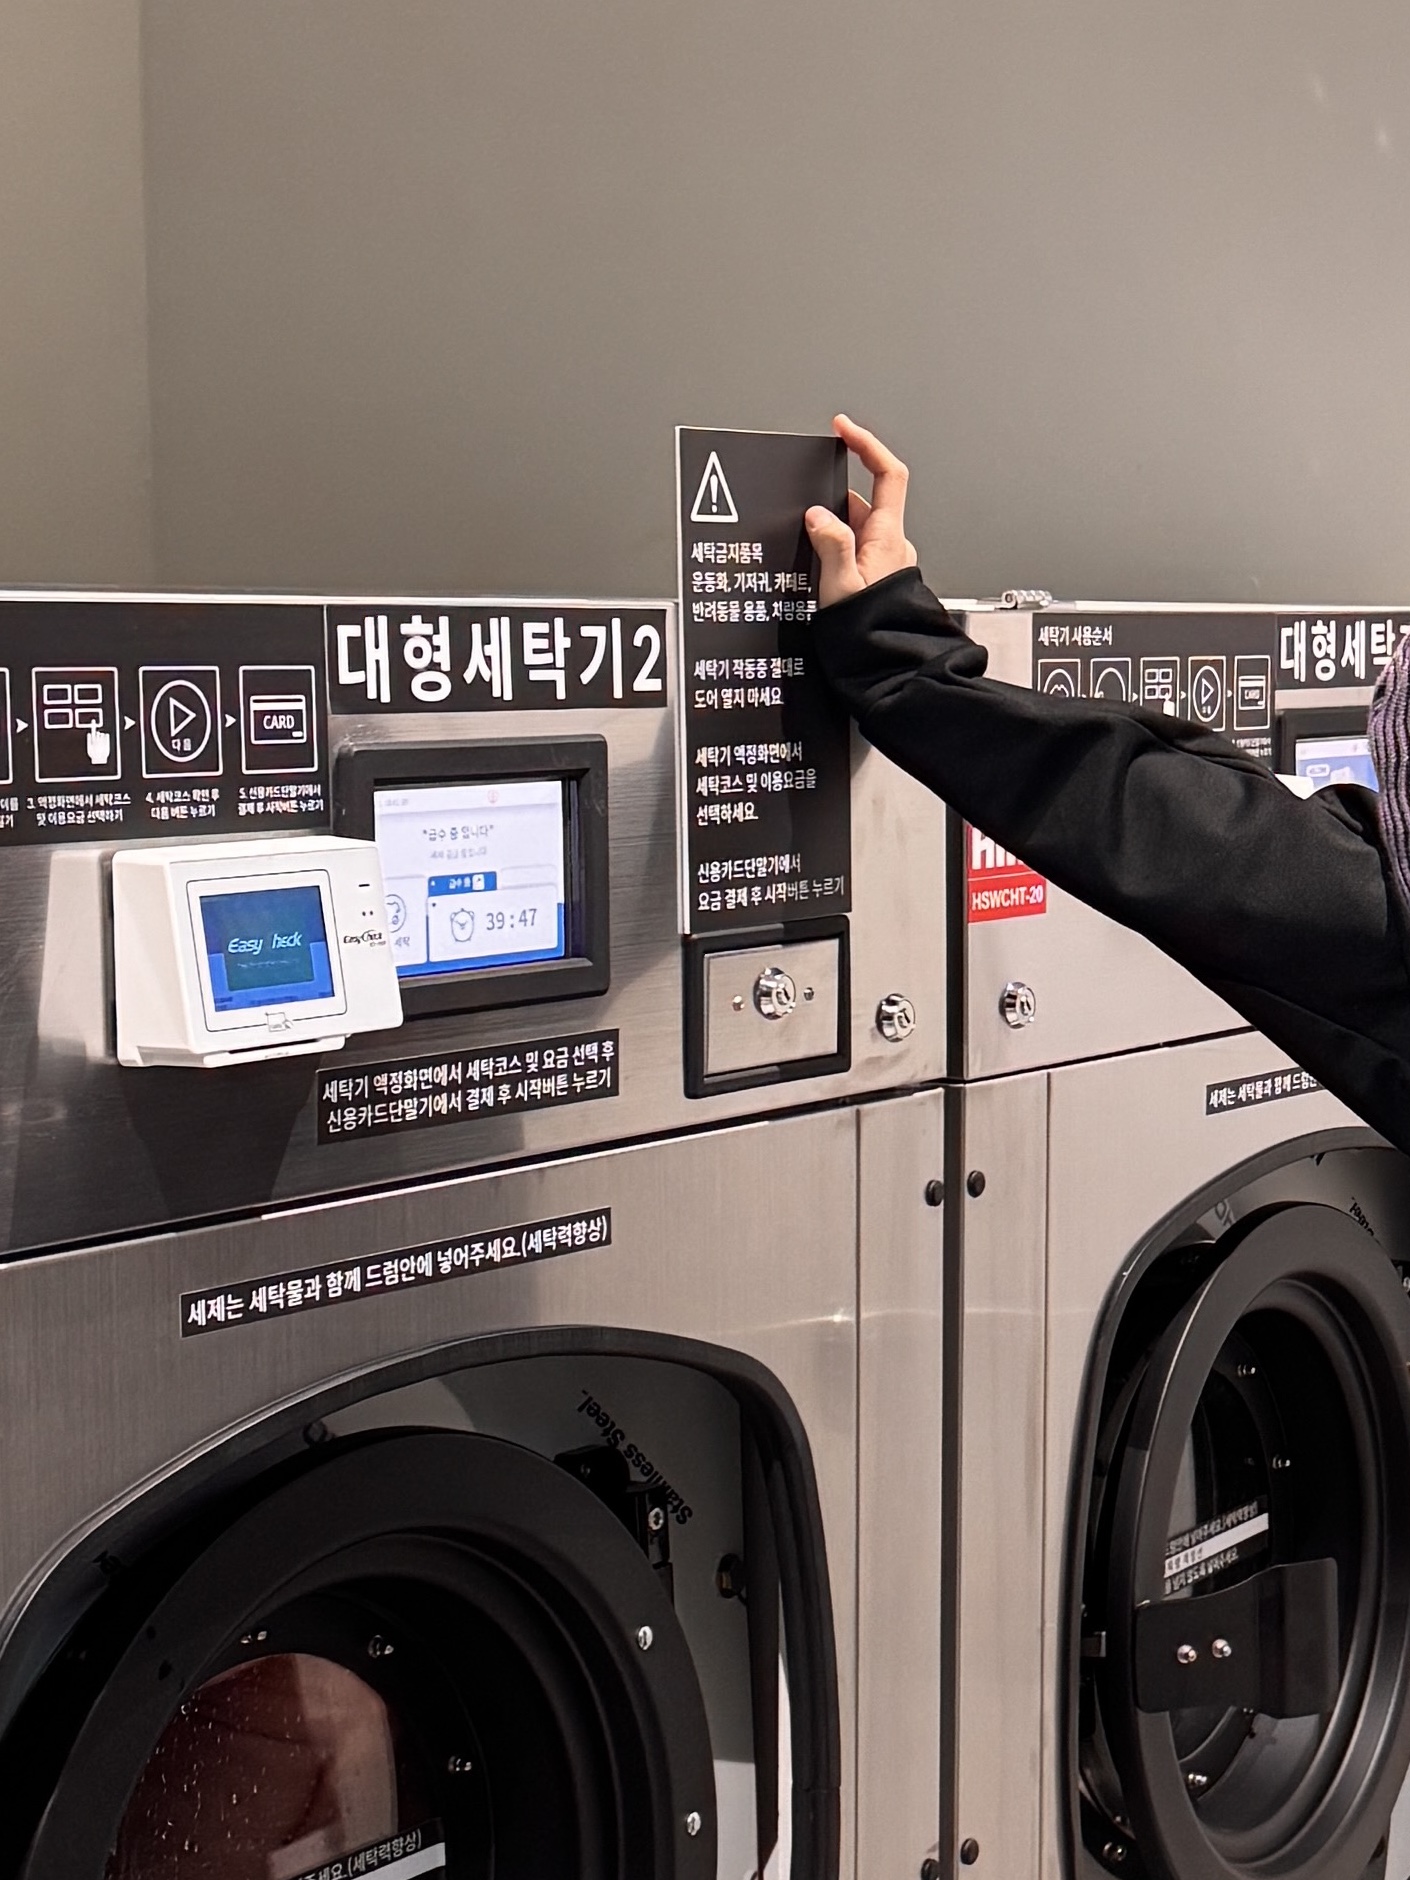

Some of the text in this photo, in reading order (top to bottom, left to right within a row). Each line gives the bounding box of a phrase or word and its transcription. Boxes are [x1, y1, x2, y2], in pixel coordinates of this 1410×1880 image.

[337, 615, 662, 703] 대형세탁기2
[1280, 619, 1410, 682] 대형세탁
[694, 659, 729, 680] 세탁기
[694, 688, 718, 709] 도어
[263, 714, 295, 730] CARD
[695, 745, 731, 768] 세탁기
[696, 775, 744, 797] 세탁코스
[698, 853, 801, 884] 신용카드단말기에서
[698, 890, 722, 912] 요금
[750, 885, 762, 906] 후
[812, 875, 845, 898] 누르기
[971, 884, 1044, 911] HSWCHT-20
[486, 908, 537, 931] 39:47
[228, 938, 263, 955] Easy
[323, 1041, 615, 1103] 세탁기 액정화면에서 세탁코스 및 요금 선택 후
[327, 1068, 612, 1133] 신용카드단말기에서 결제 후 시작버튼 누르기
[187, 1293, 243, 1327] 세제는
[249, 1275, 322, 1316] 세탁물과
[326, 1266, 361, 1299] 함께
[364, 1250, 433, 1290] 드럼안에
